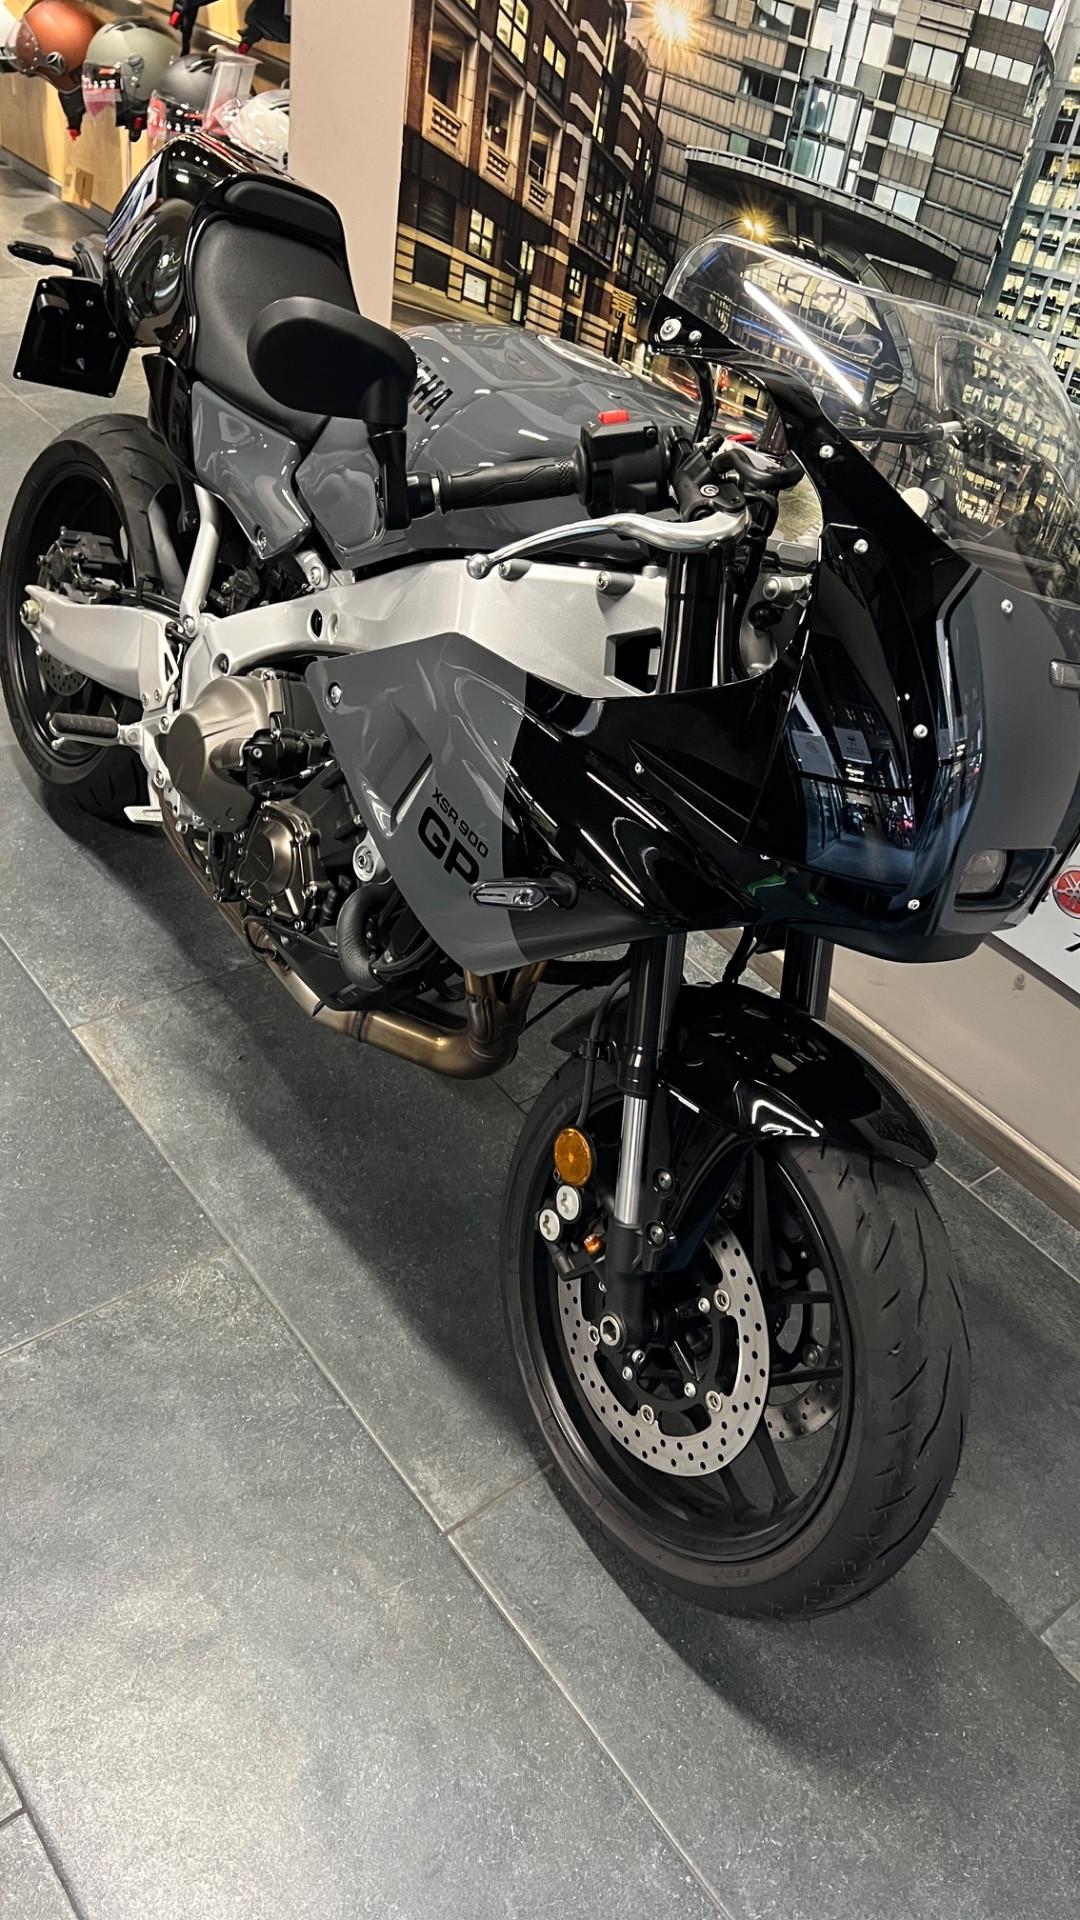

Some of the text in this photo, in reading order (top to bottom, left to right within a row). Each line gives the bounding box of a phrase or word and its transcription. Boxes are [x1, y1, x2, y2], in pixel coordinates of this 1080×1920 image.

[418, 807, 479, 885] GP
[432, 786, 488, 858] XSR 900
